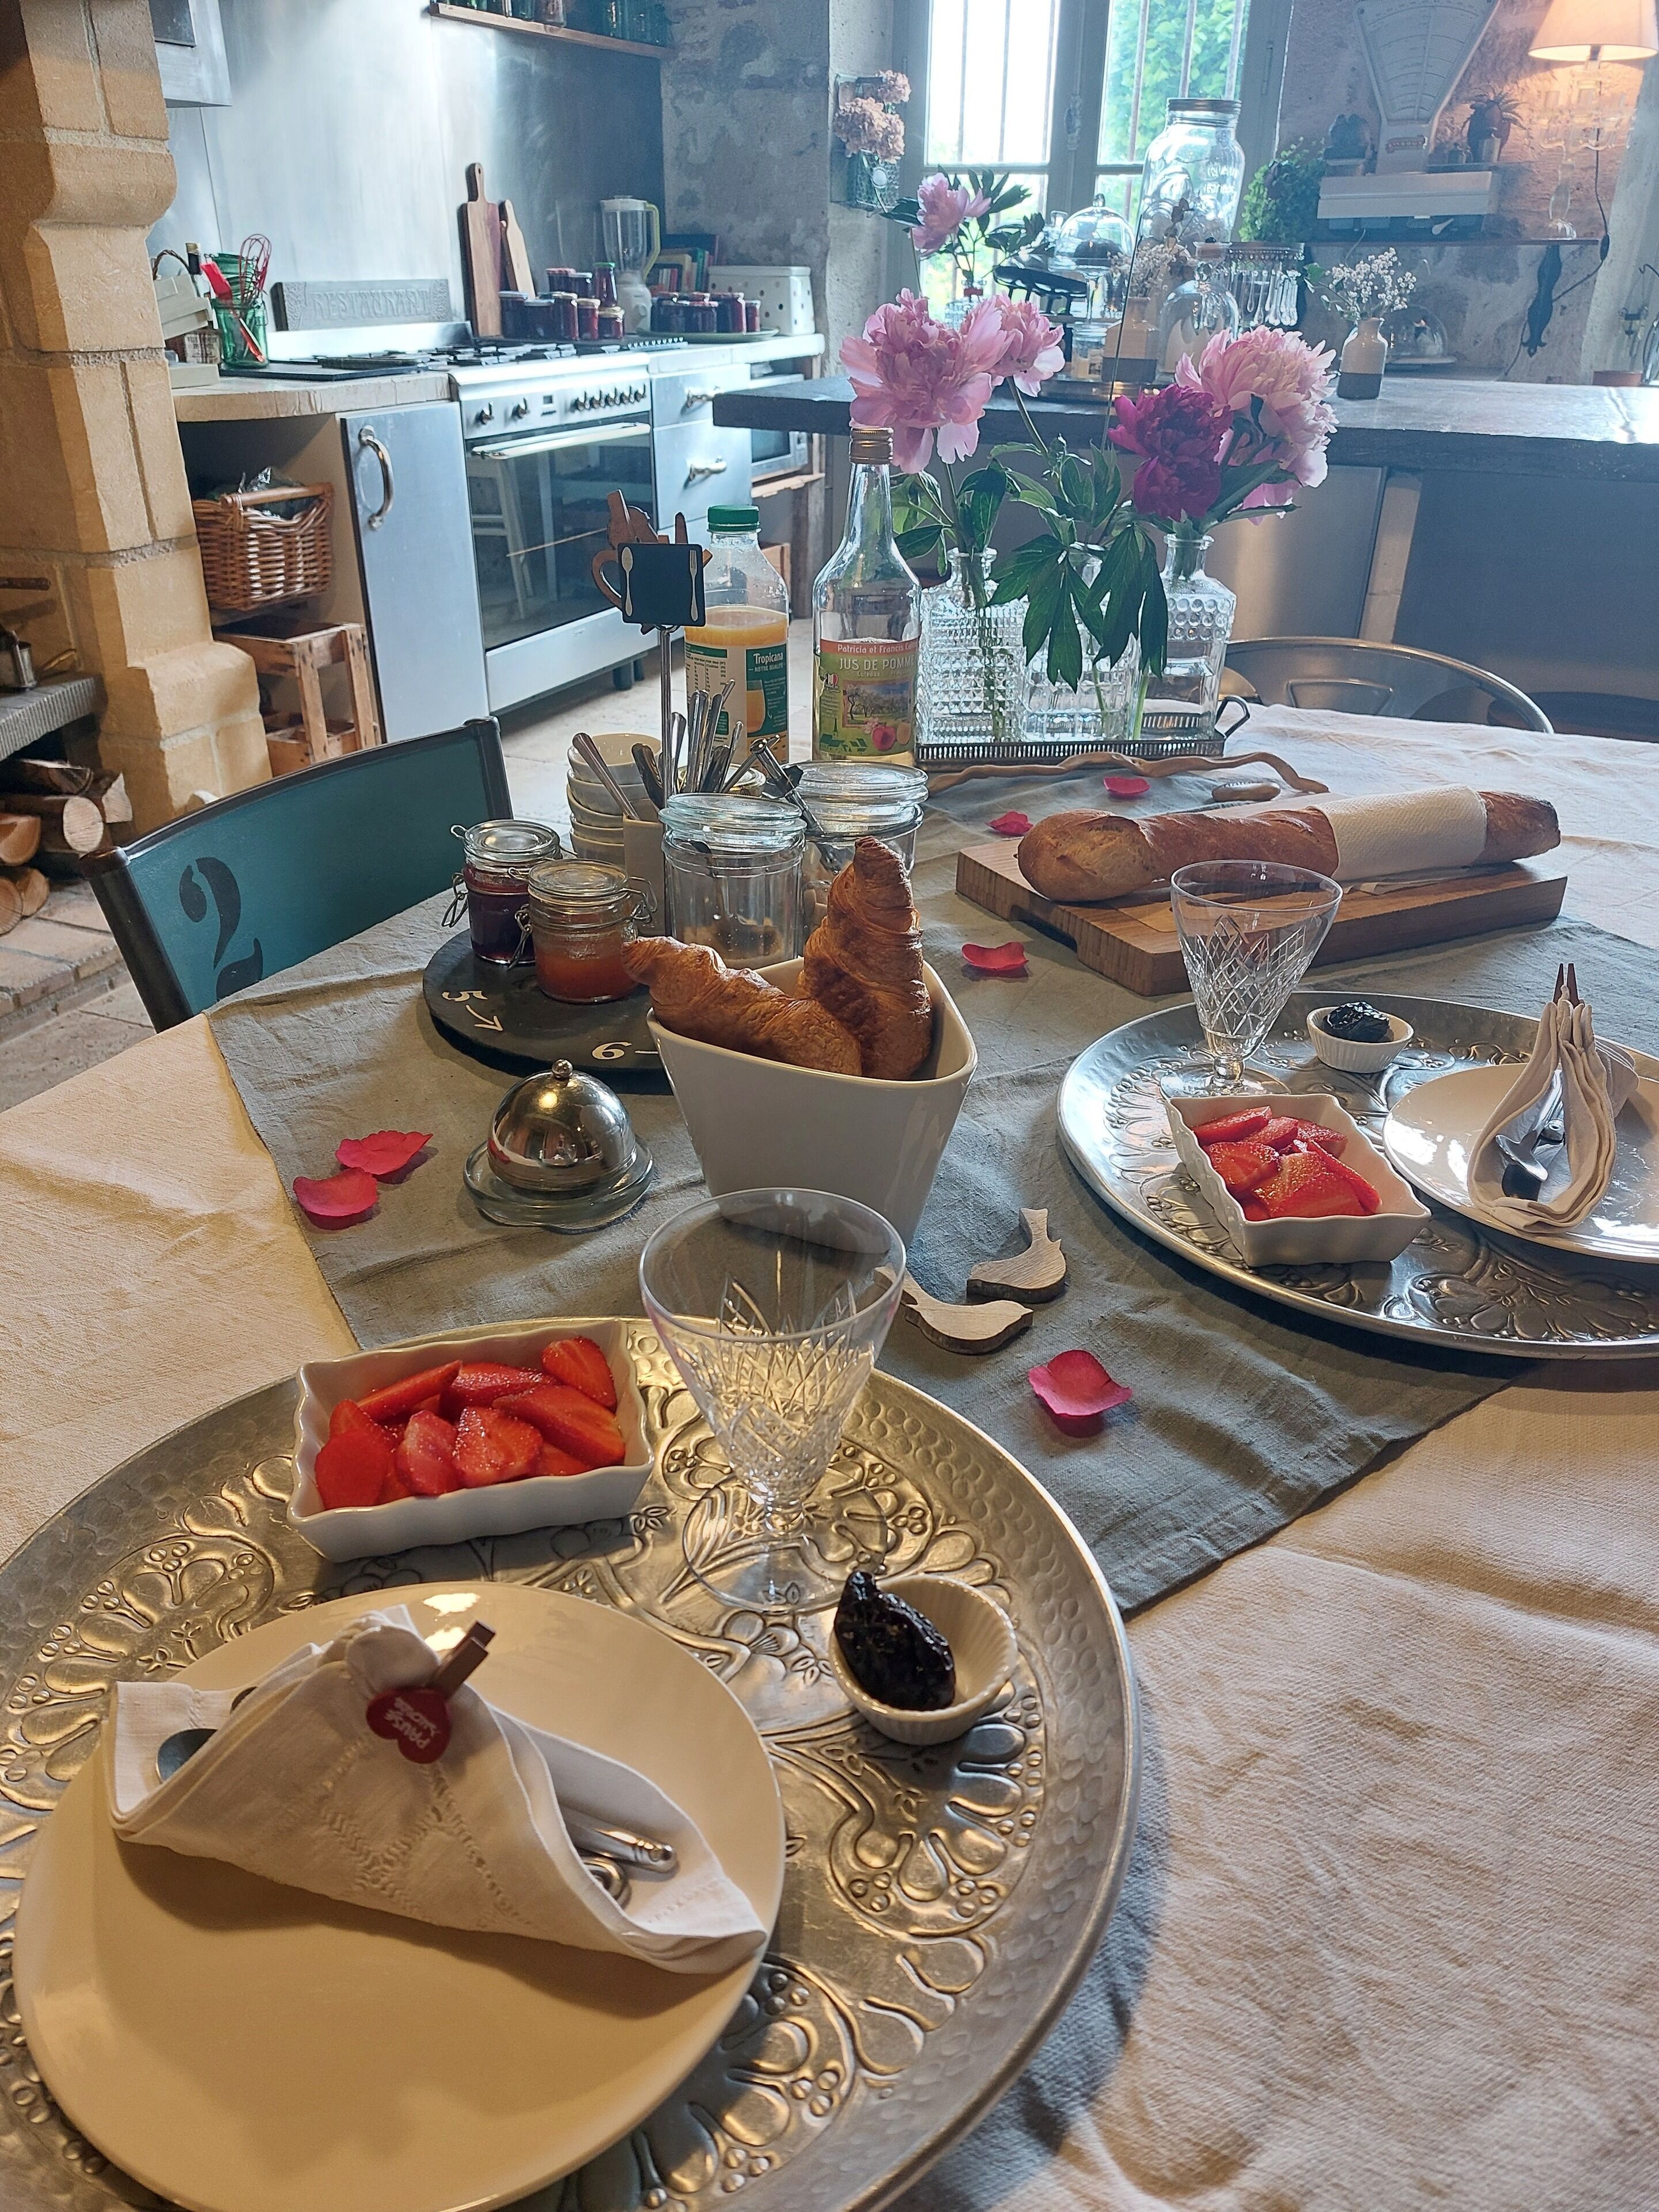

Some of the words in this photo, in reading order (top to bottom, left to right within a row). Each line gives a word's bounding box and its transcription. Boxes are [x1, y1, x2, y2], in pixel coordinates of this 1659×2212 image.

[311, 289, 430, 320] RESTAURANT
[838, 644, 867, 653] Patricia
[879, 645, 904, 653] Francis
[753, 652, 783, 665] Tropicana
[839, 658, 860, 671] JUS
[863, 660, 878, 671] DE
[882, 654, 915, 670] POMME
[179, 857, 263, 1002] 2
[442, 990, 488, 1002] 5
[592, 1041, 632, 1060] 6
[384, 1709, 430, 1749] PAUSE
